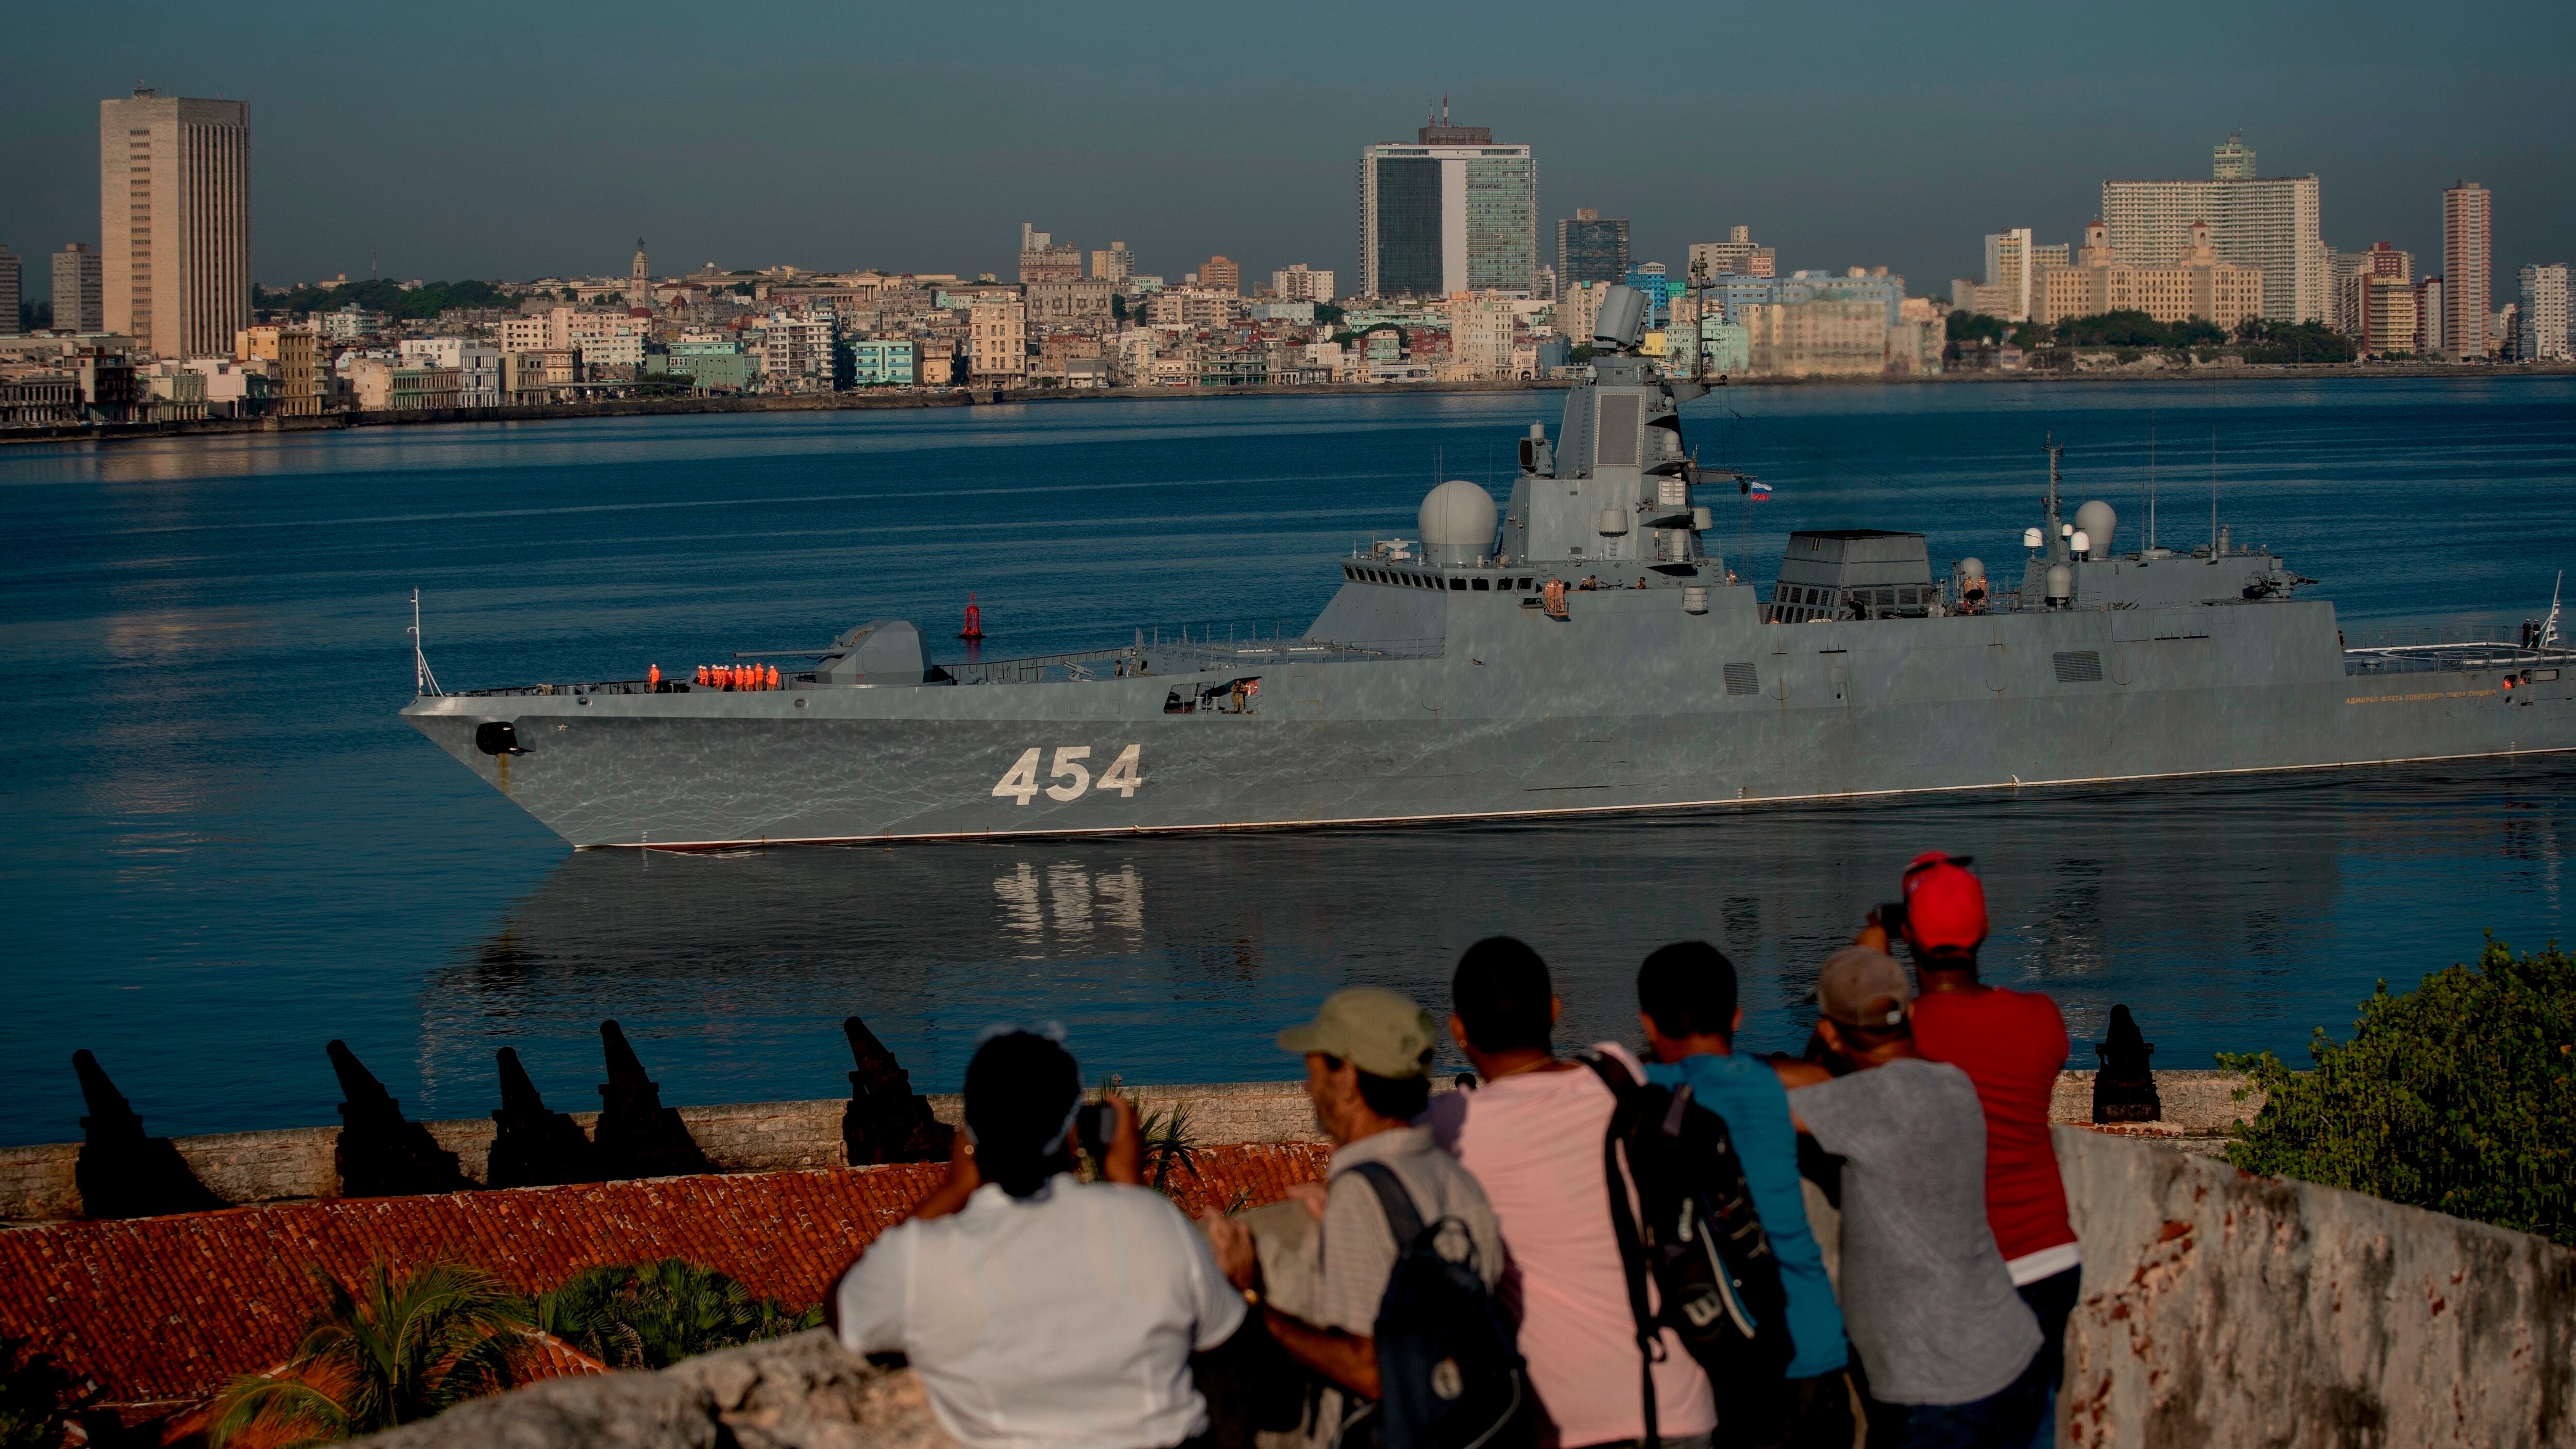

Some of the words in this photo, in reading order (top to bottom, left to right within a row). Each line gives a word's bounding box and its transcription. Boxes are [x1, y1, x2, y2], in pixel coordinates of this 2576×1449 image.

[2346, 696, 2378, 705] АДМИРАЛ
[2405, 693, 2443, 701] СОВЕТСКОГО
[992, 744, 1142, 805] 454
